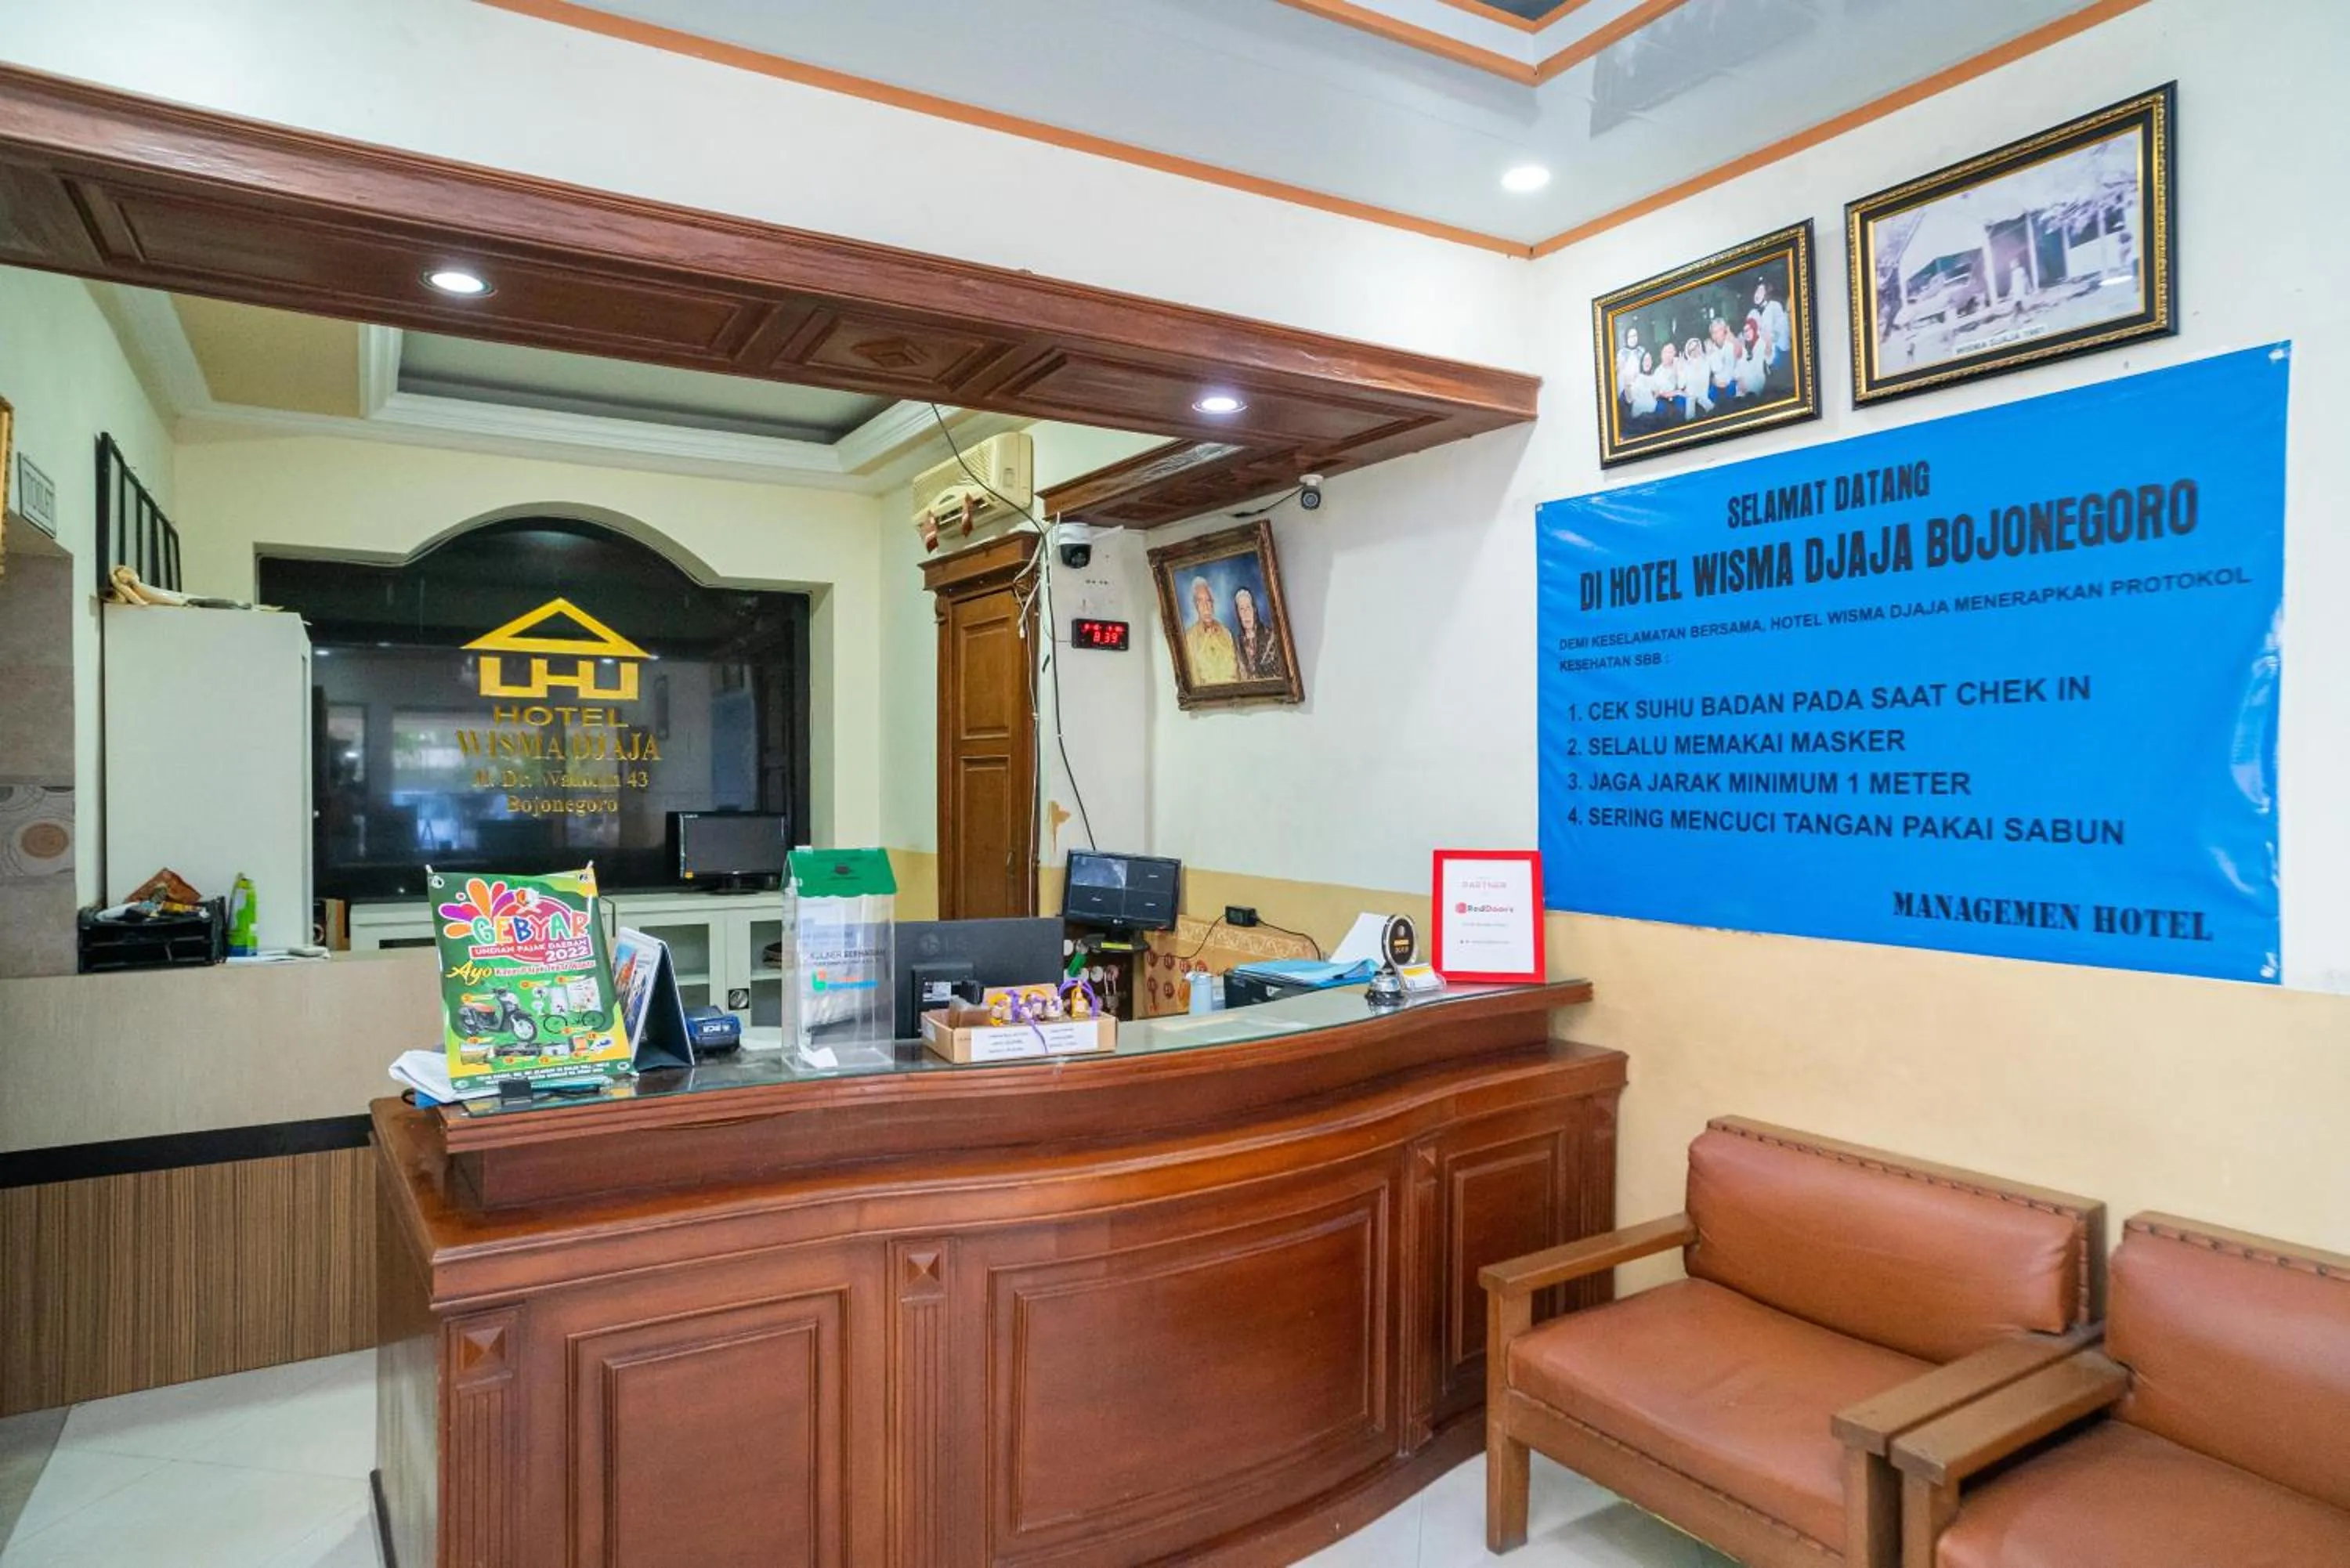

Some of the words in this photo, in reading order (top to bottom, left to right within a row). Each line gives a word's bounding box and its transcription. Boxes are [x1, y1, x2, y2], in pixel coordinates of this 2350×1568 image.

[1727, 479, 1827, 529] SELAMAT
[1835, 461, 1931, 511] DATANG
[1580, 570, 1602, 612] DI
[1610, 559, 1682, 607] HOTEL
[1693, 541, 1794, 598] WISMA
[1804, 523, 1914, 583] DJAJA
[1927, 479, 2200, 568] BOJONEGORO
[1559, 636, 1589, 650] DEMI
[1591, 627, 1687, 649] KESELAMATAN
[1690, 620, 1763, 638] BERSAMA,
[1770, 612, 1822, 630] HOTEL
[1827, 604, 1885, 624] WISMA
[1890, 599, 1950, 620] DJAJA
[1954, 583, 2103, 612] MENERAPKAN
[2110, 566, 2253, 596] PROTOKOL
[1559, 656, 1632, 672] KESEHATAN
[1635, 652, 1661, 666] SBB
[1568, 703, 1582, 721] 1.
[1588, 701, 1629, 721] CEK
[1635, 697, 1694, 720] SUHU
[1701, 692, 1784, 717] BADAN
[1792, 688, 1864, 713] PADA
[1871, 683, 1947, 710] SAAT
[1956, 677, 2048, 706] CHEK
[2057, 674, 2092, 701] IN
[493, 705, 629, 728] HOTEL
[457, 728, 565, 761] WISMA
[573, 731, 663, 761] DJAJA
[1567, 737, 1582, 757] 2.
[1588, 736, 1668, 756] SELALU
[1674, 732, 1784, 756] MEMAKAI
[1791, 729, 1906, 753] MASKER
[627, 770, 649, 788] 43
[1567, 772, 1582, 791] 3.
[1588, 772, 1643, 792] JAGA
[1647, 771, 1722, 793] JARAK
[1728, 771, 1838, 794] MINIMUM
[1846, 771, 1859, 795] 1
[1869, 771, 1972, 796] METER
[507, 794, 618, 818] Bojonegoro
[1567, 806, 1582, 824] 4.
[1588, 807, 1664, 829] SERING
[1670, 809, 1775, 833] MENCUCI
[1782, 812, 1893, 837] TANGAN
[1903, 815, 1993, 840] PAKAI
[2004, 817, 2124, 846] SABUN
[472, 911, 590, 945] GEBYAR
[1893, 891, 2081, 931] MANAGEMEN
[2092, 905, 2214, 941] HOTEL
[544, 945, 589, 963] 2022
[445, 959, 494, 986] Ayo
